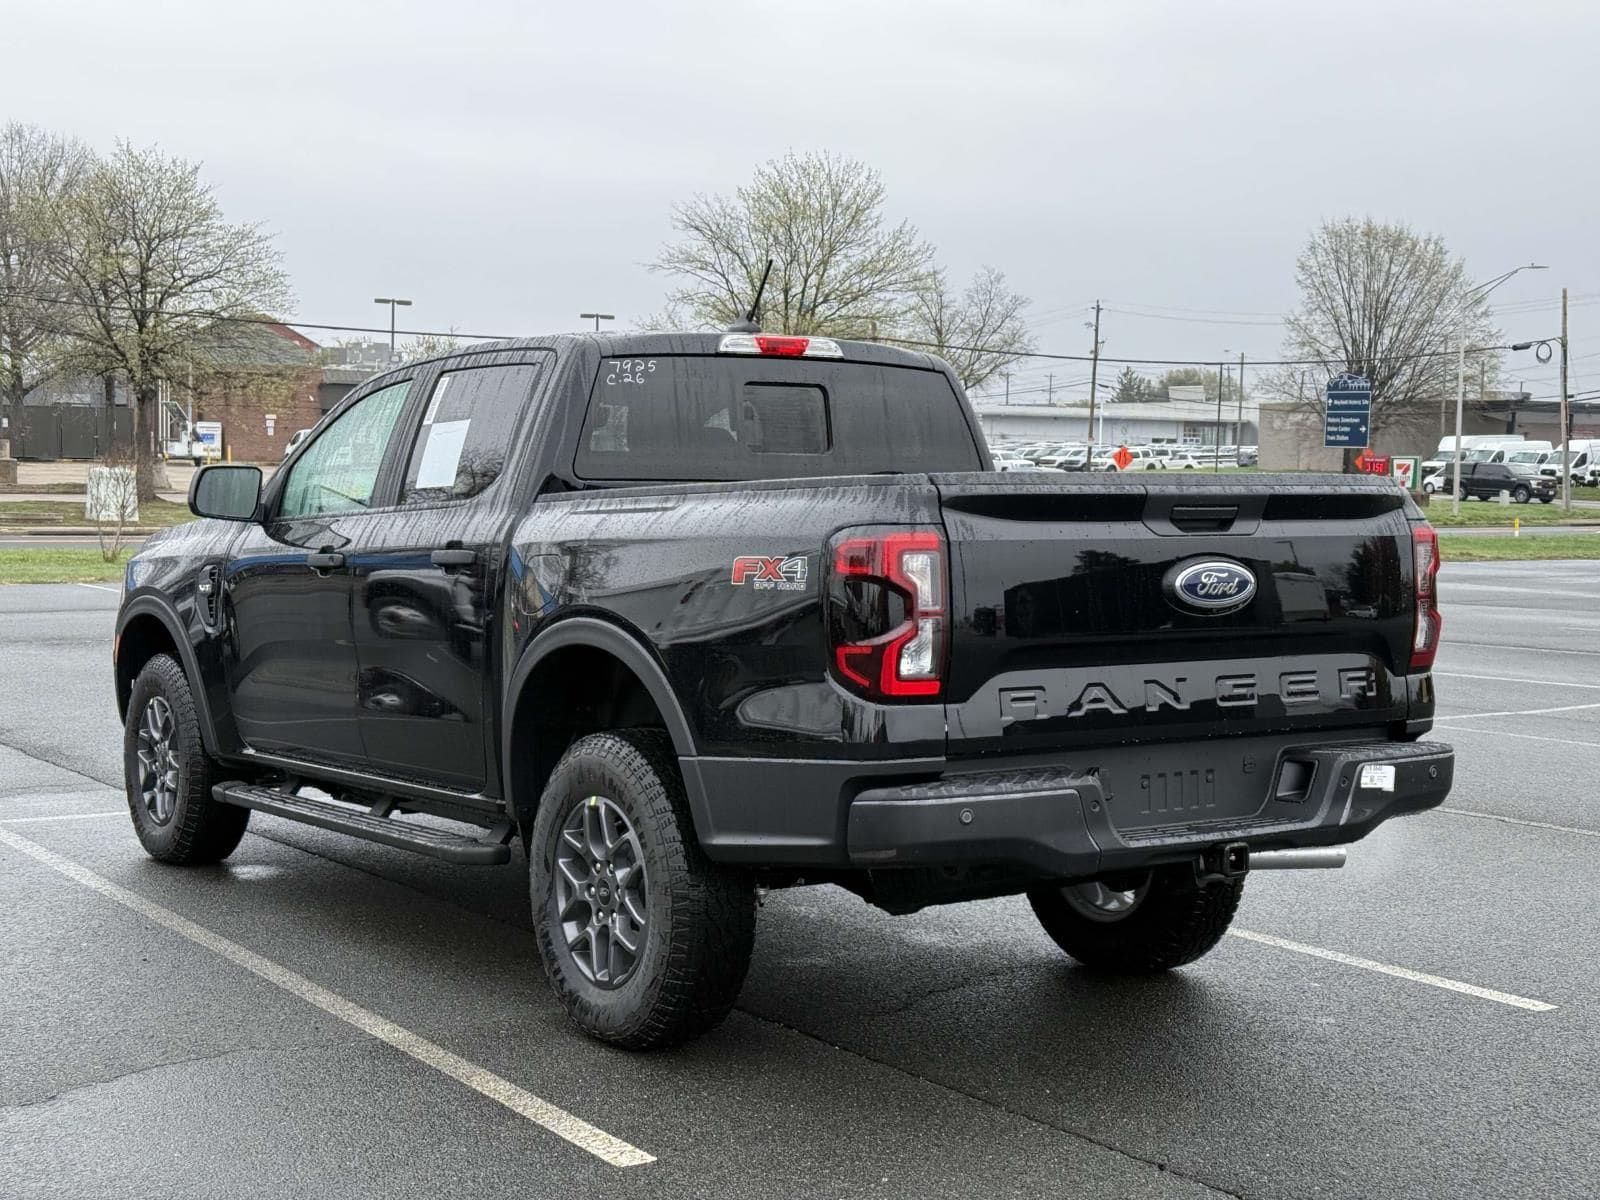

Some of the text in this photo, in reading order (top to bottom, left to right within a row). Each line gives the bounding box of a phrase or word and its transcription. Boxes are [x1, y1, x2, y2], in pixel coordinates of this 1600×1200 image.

[608, 359, 657, 373] 7925
[731, 555, 808, 585] FX4
[753, 581, 807, 591] OFF ROAD
[1196, 571, 1239, 596] Ford
[998, 666, 1378, 721] RANGER
